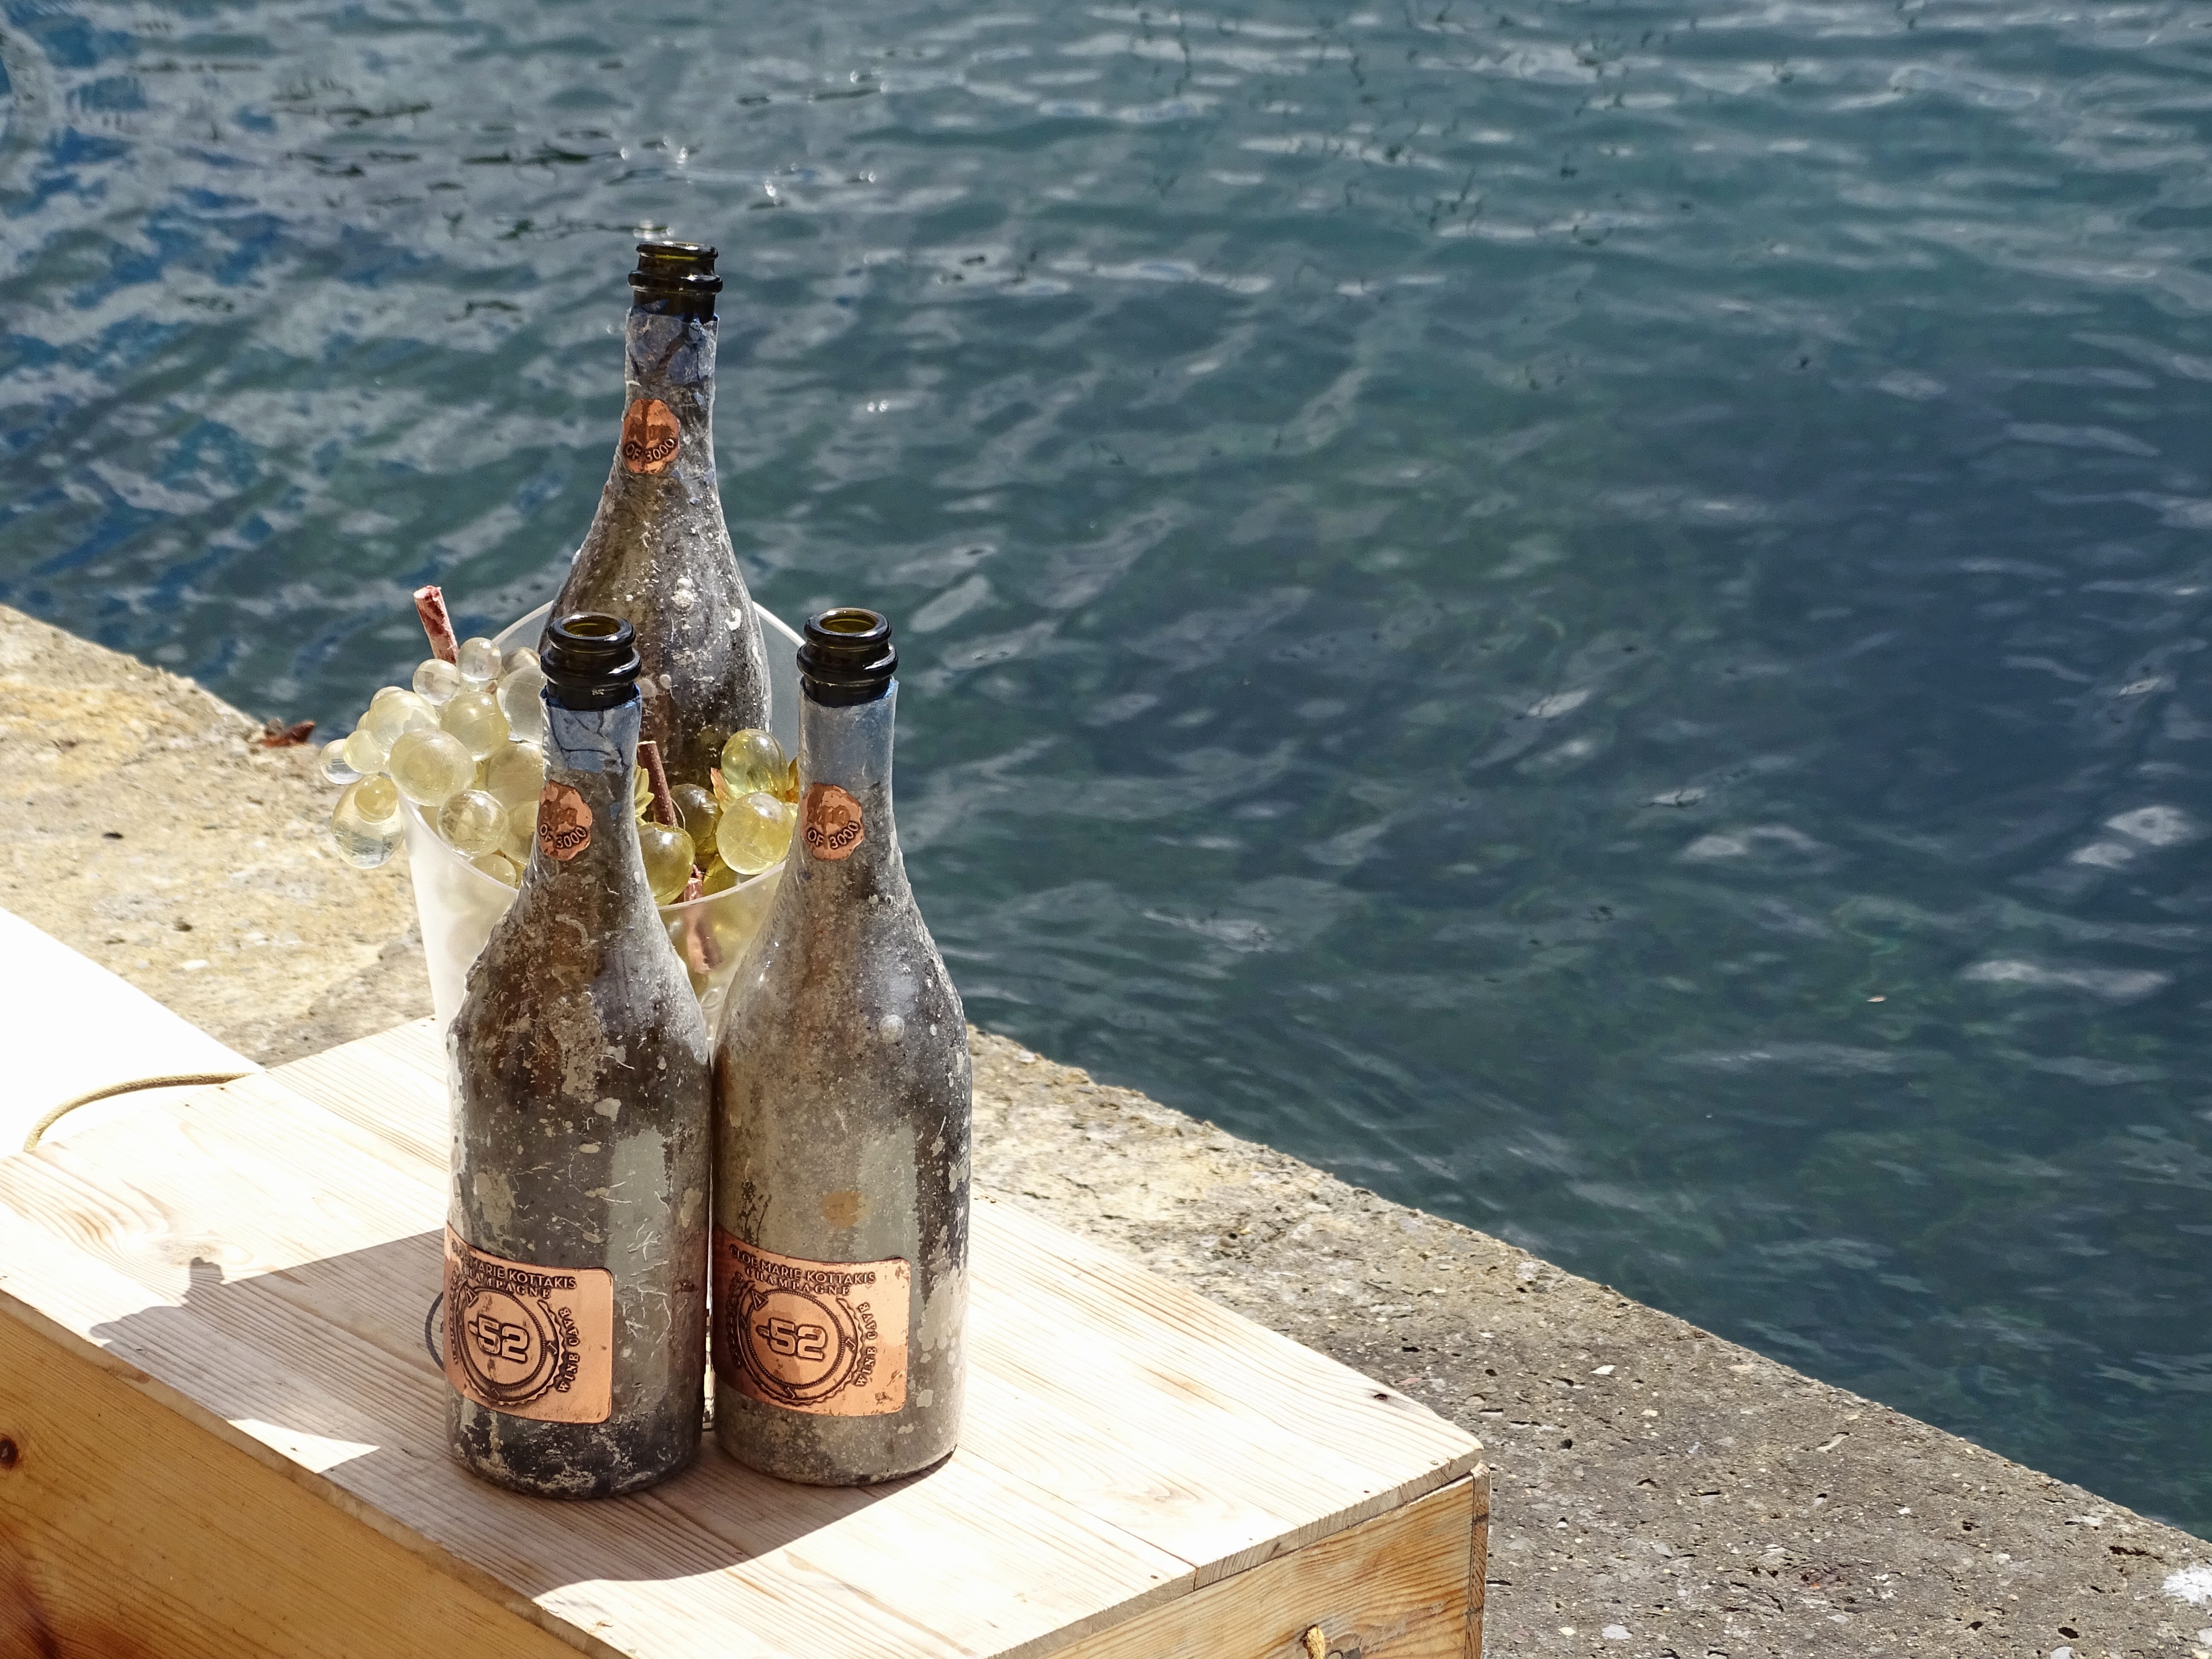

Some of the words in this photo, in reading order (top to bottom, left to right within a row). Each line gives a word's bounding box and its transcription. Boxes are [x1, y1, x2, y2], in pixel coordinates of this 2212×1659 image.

[645, 439, 675, 462] 3000
[556, 827, 586, 848] 3000
[807, 829, 824, 846] OF
[830, 821, 859, 849] 3000
[463, 1263, 550, 1298] CHAMPAGNE
[470, 1258, 505, 1279] MARIE
[509, 1270, 576, 1288] KOTTAKIS
[747, 1268, 850, 1295] CHAMPAGNE
[761, 1260, 802, 1280] MARIE
[807, 1271, 876, 1285] KOTTAKIS
[559, 1307, 580, 1346] CAVE
[858, 1302, 877, 1340] CAVE
[558, 1353, 579, 1392] WINE
[855, 1347, 877, 1386] WINE
